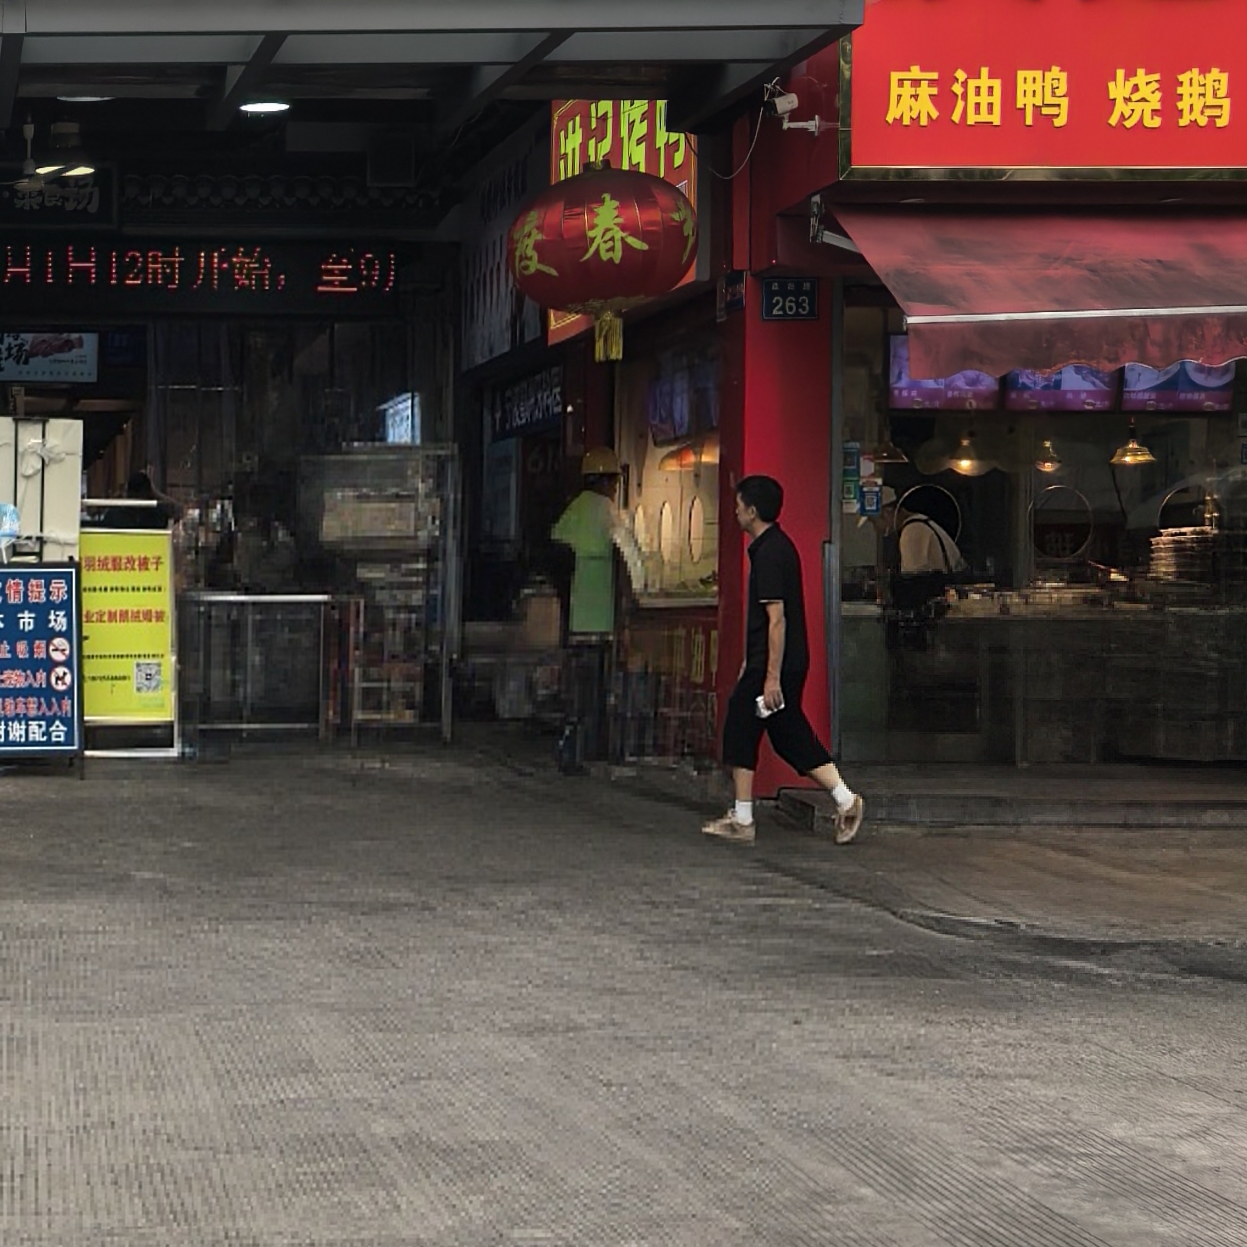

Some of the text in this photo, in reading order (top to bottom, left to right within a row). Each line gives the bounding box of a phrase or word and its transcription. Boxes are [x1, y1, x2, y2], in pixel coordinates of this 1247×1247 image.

[885, 65, 1232, 129] 麻油鸭 烧鹅
[772, 296, 809, 315] 263
